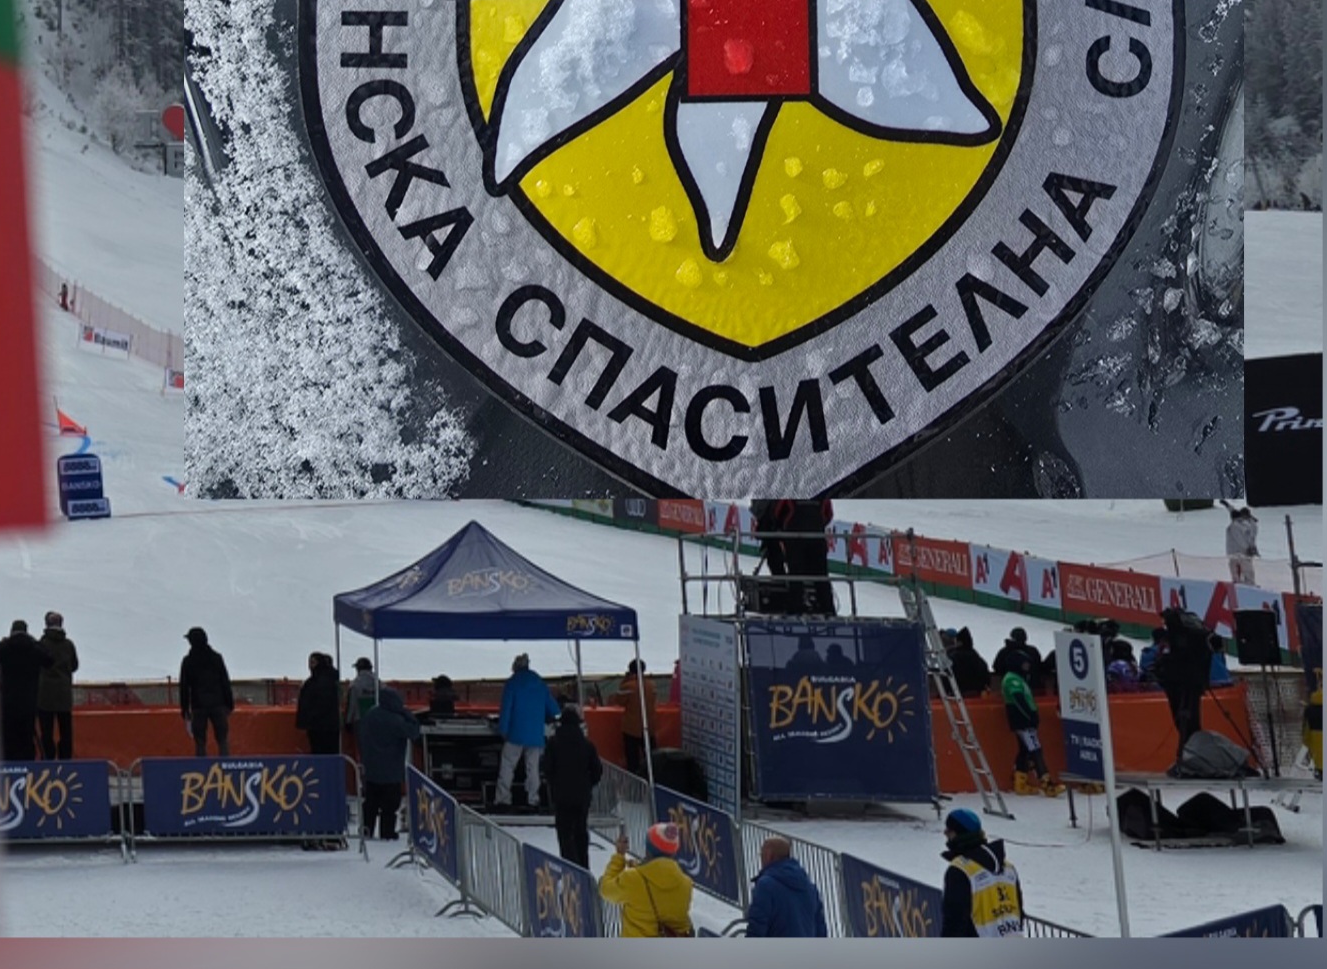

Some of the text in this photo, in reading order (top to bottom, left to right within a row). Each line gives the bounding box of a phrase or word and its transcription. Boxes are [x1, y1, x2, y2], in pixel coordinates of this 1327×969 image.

[495, 170, 1118, 463] СПАСИТЕЛНА
[1084, 578, 1157, 613] GENERALI
[1073, 646, 1085, 673] 5
[768, 675, 898, 743] BANSKO
[180, 762, 304, 827] BANSKO
